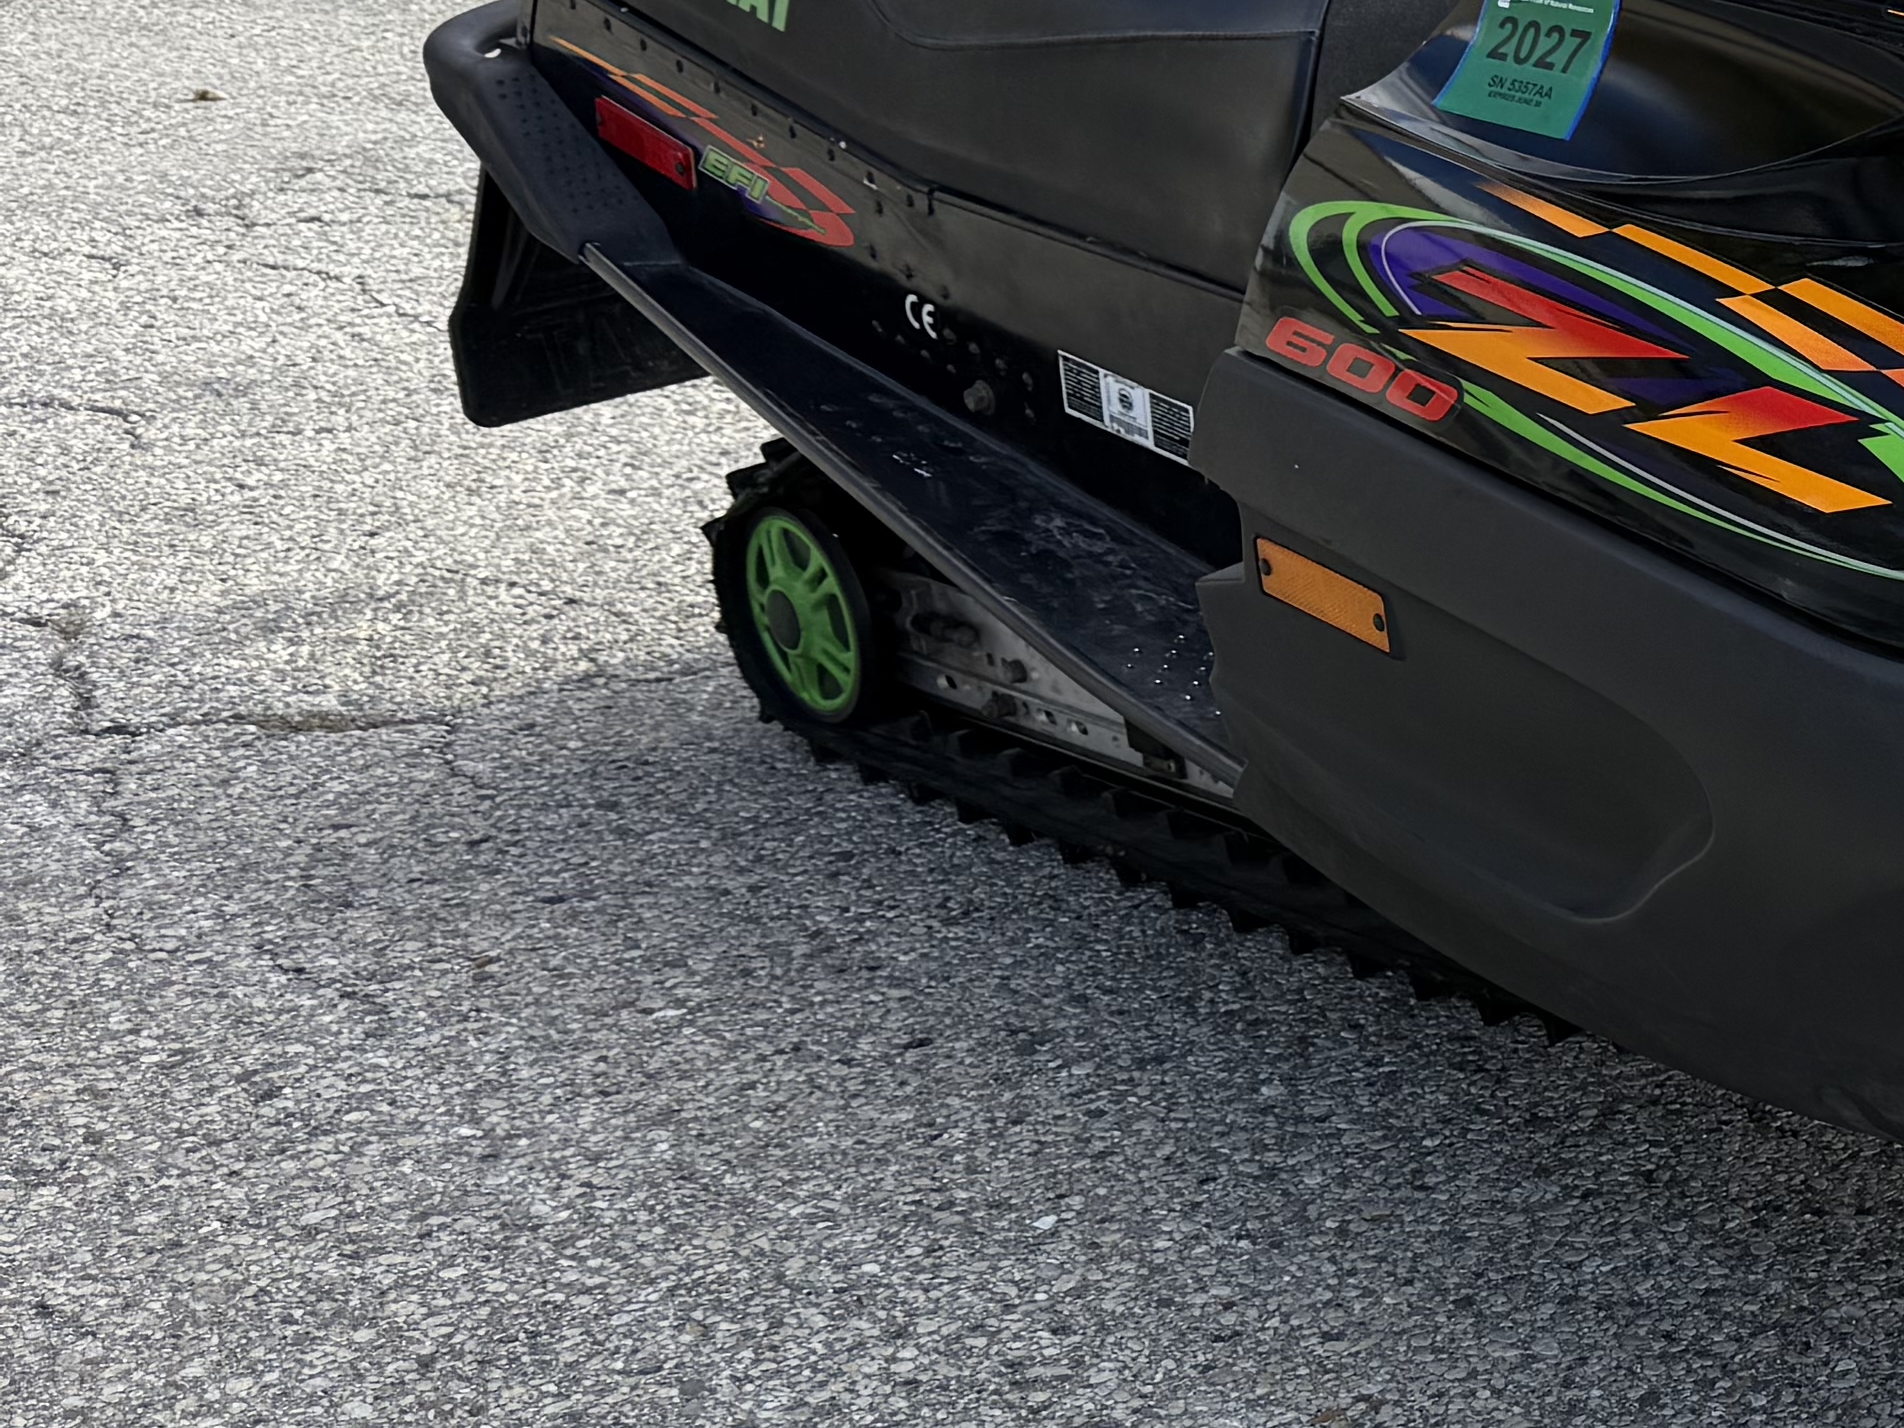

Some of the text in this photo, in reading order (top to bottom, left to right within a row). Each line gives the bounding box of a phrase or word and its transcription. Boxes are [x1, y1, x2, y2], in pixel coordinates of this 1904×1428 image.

[1486, 16, 1592, 74] 2027
[1487, 75, 1509, 89] SN
[699, 145, 770, 203] EFI
[1264, 315, 1460, 421] 600
